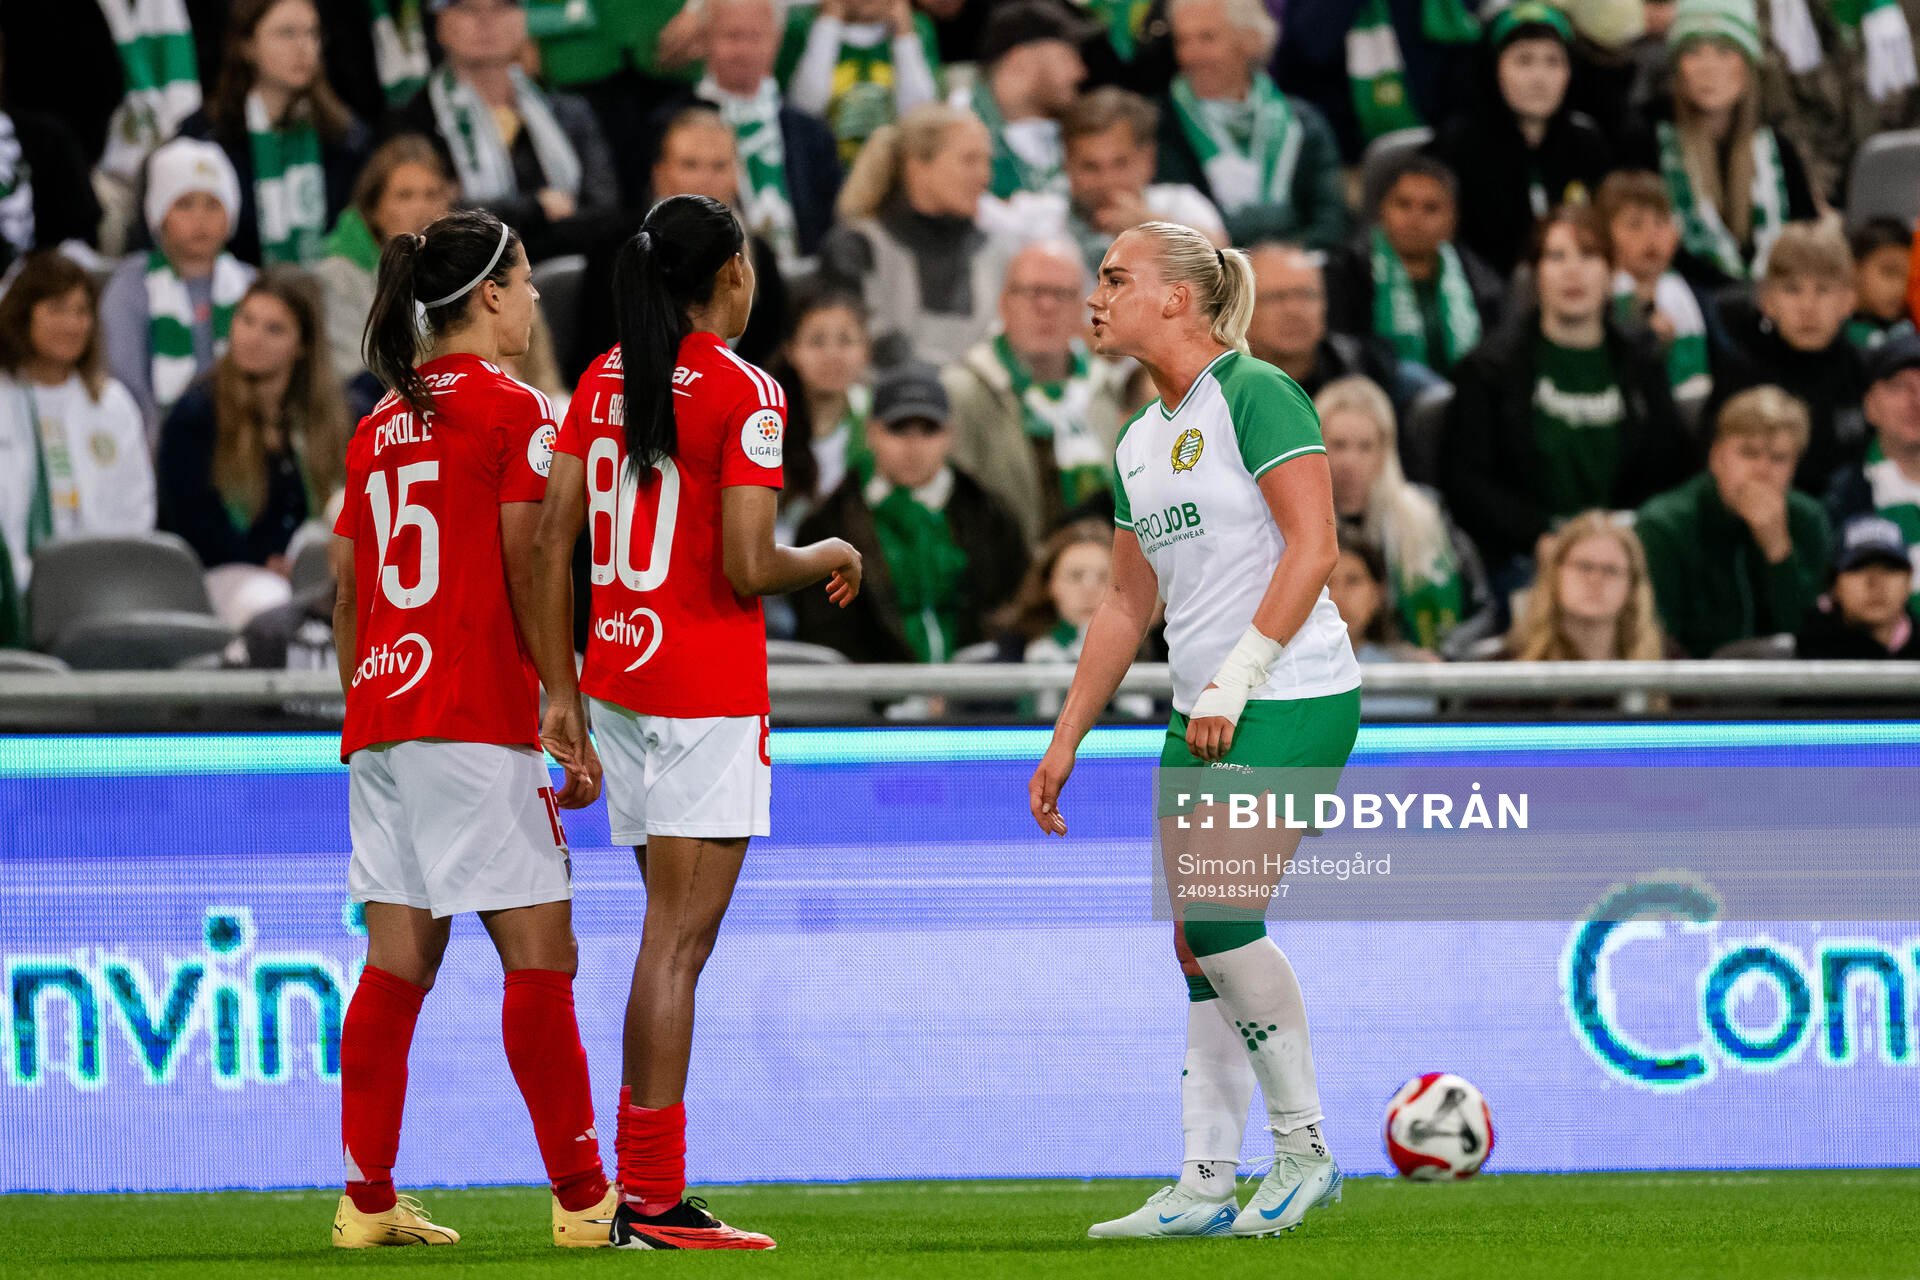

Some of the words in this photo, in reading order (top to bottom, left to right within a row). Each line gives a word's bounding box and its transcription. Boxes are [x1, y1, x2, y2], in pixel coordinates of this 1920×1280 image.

[587, 437, 681, 592] 80
[749, 446, 771, 457] LIGA
[364, 460, 440, 610] 15
[1567, 878, 1920, 1088] Con
